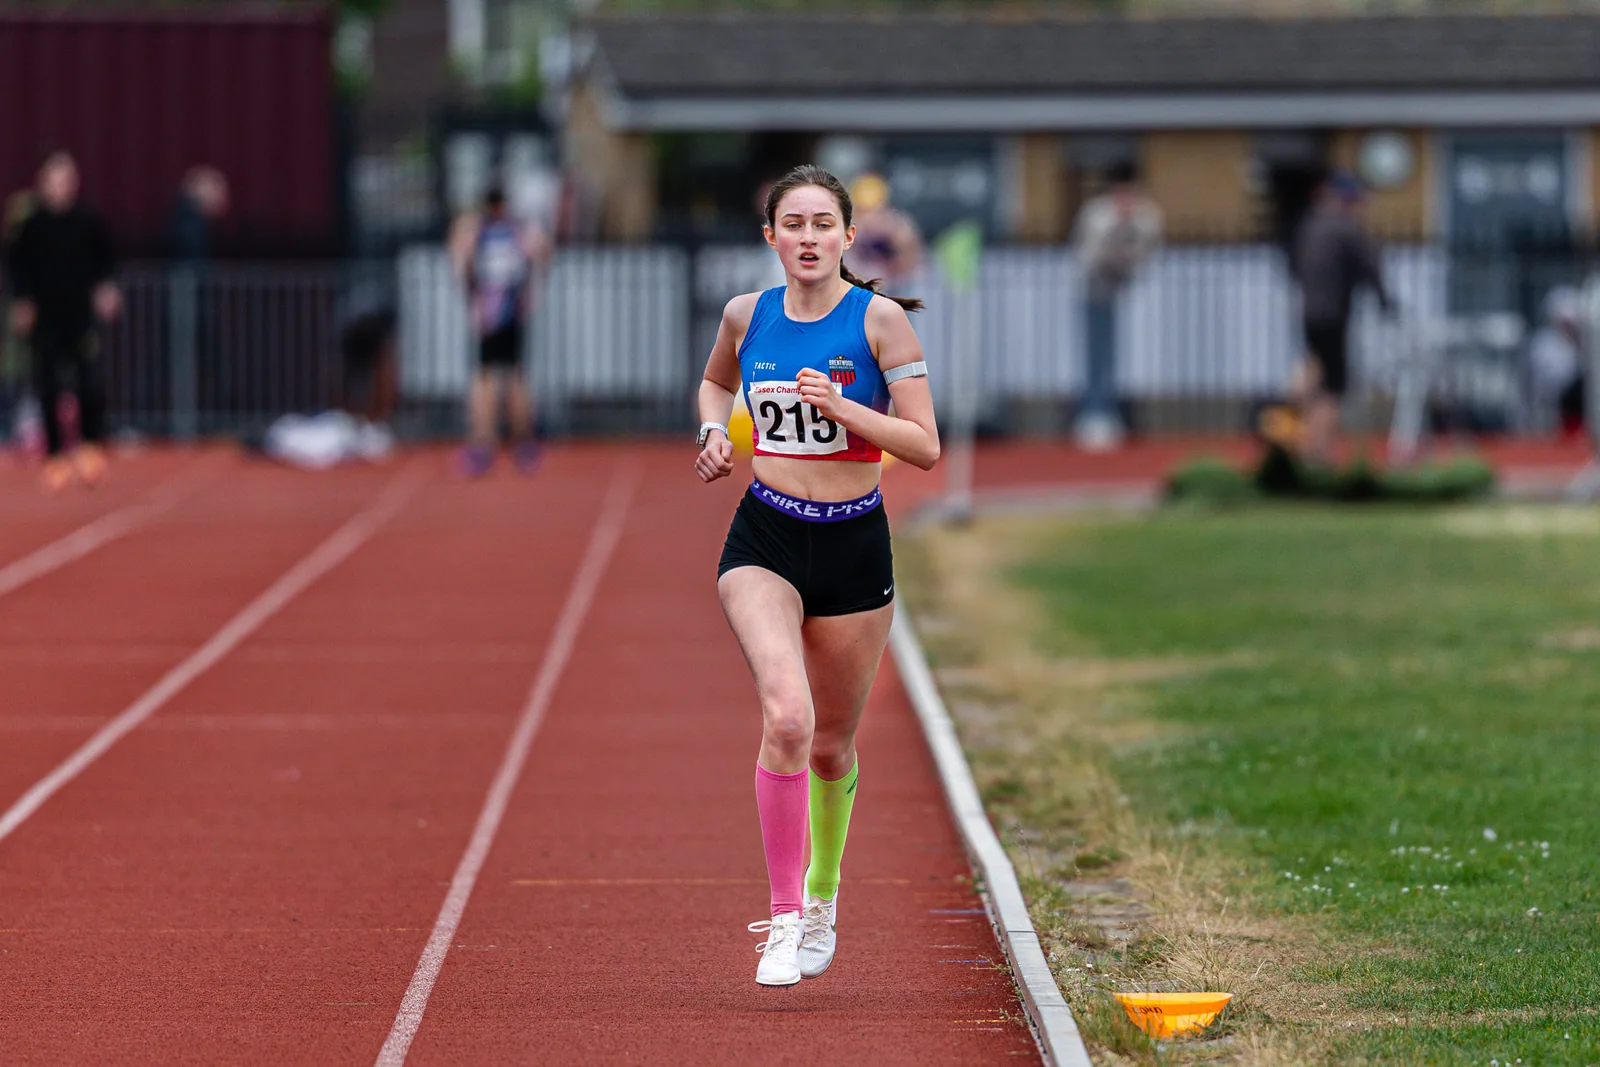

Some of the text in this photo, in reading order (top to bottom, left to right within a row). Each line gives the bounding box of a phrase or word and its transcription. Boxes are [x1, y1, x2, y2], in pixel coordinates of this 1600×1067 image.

[754, 362, 776, 371] TACTIC
[828, 359, 854, 367] BRENTWOOD
[754, 386, 775, 394] Essex
[760, 400, 838, 444] 215
[762, 489, 878, 517] NIKE PRO
